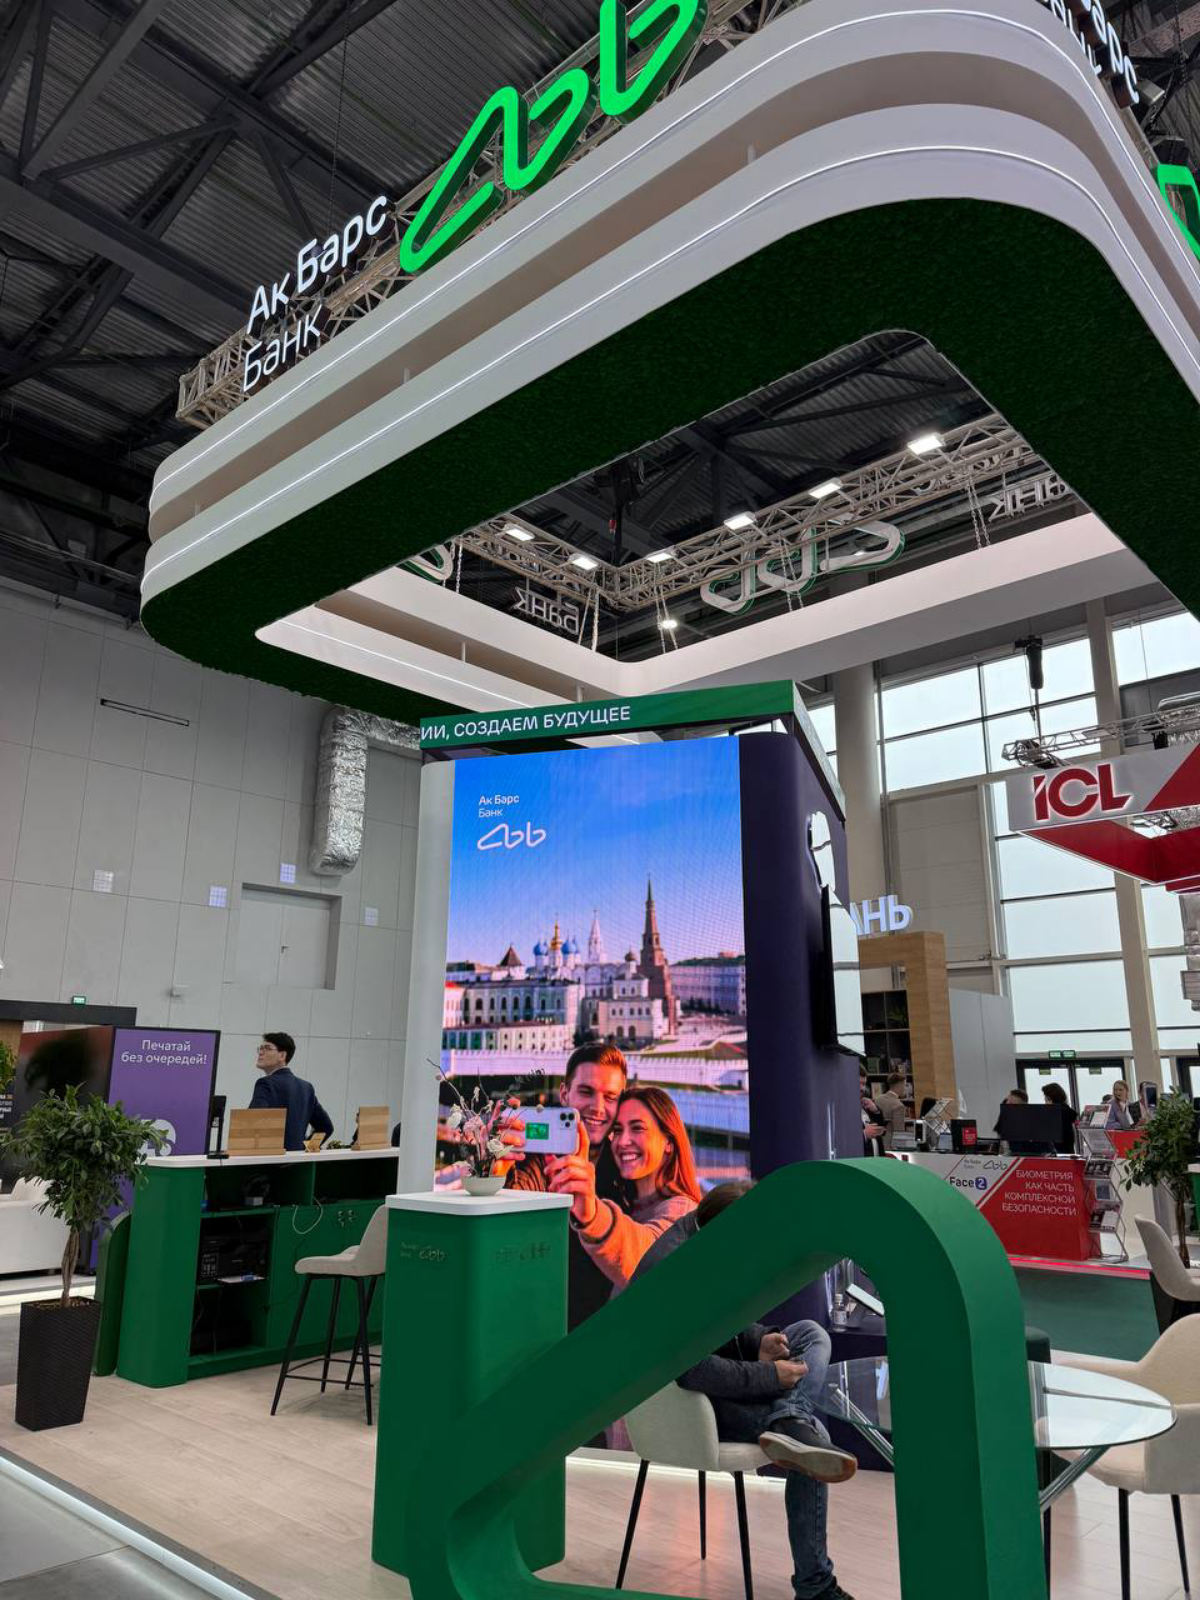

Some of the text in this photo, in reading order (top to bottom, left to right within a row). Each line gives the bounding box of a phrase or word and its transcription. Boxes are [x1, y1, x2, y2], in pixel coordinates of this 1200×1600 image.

[246, 195, 387, 335] Ак Барс
[243, 303, 324, 392] Банк
[454, 716, 538, 737] СОЗДАЕМ
[543, 706, 631, 728] БУДУЩЕЕ
[1032, 763, 1132, 821] ICL
[478, 794, 520, 806] Ак Барс
[478, 808, 503, 818] Банк
[141, 1039, 191, 1052] Печатай
[120, 1050, 207, 1066] без очередей!
[1016, 1169, 1073, 1181] БИОМЕТРИЯ
[1025, 1181, 1075, 1192] КАК ЧАСТЬ
[1004, 1191, 1076, 1204] КОМПЛЕКСНОЙ
[1002, 1202, 1077, 1216] БЕЗОПАСНОСТИ
